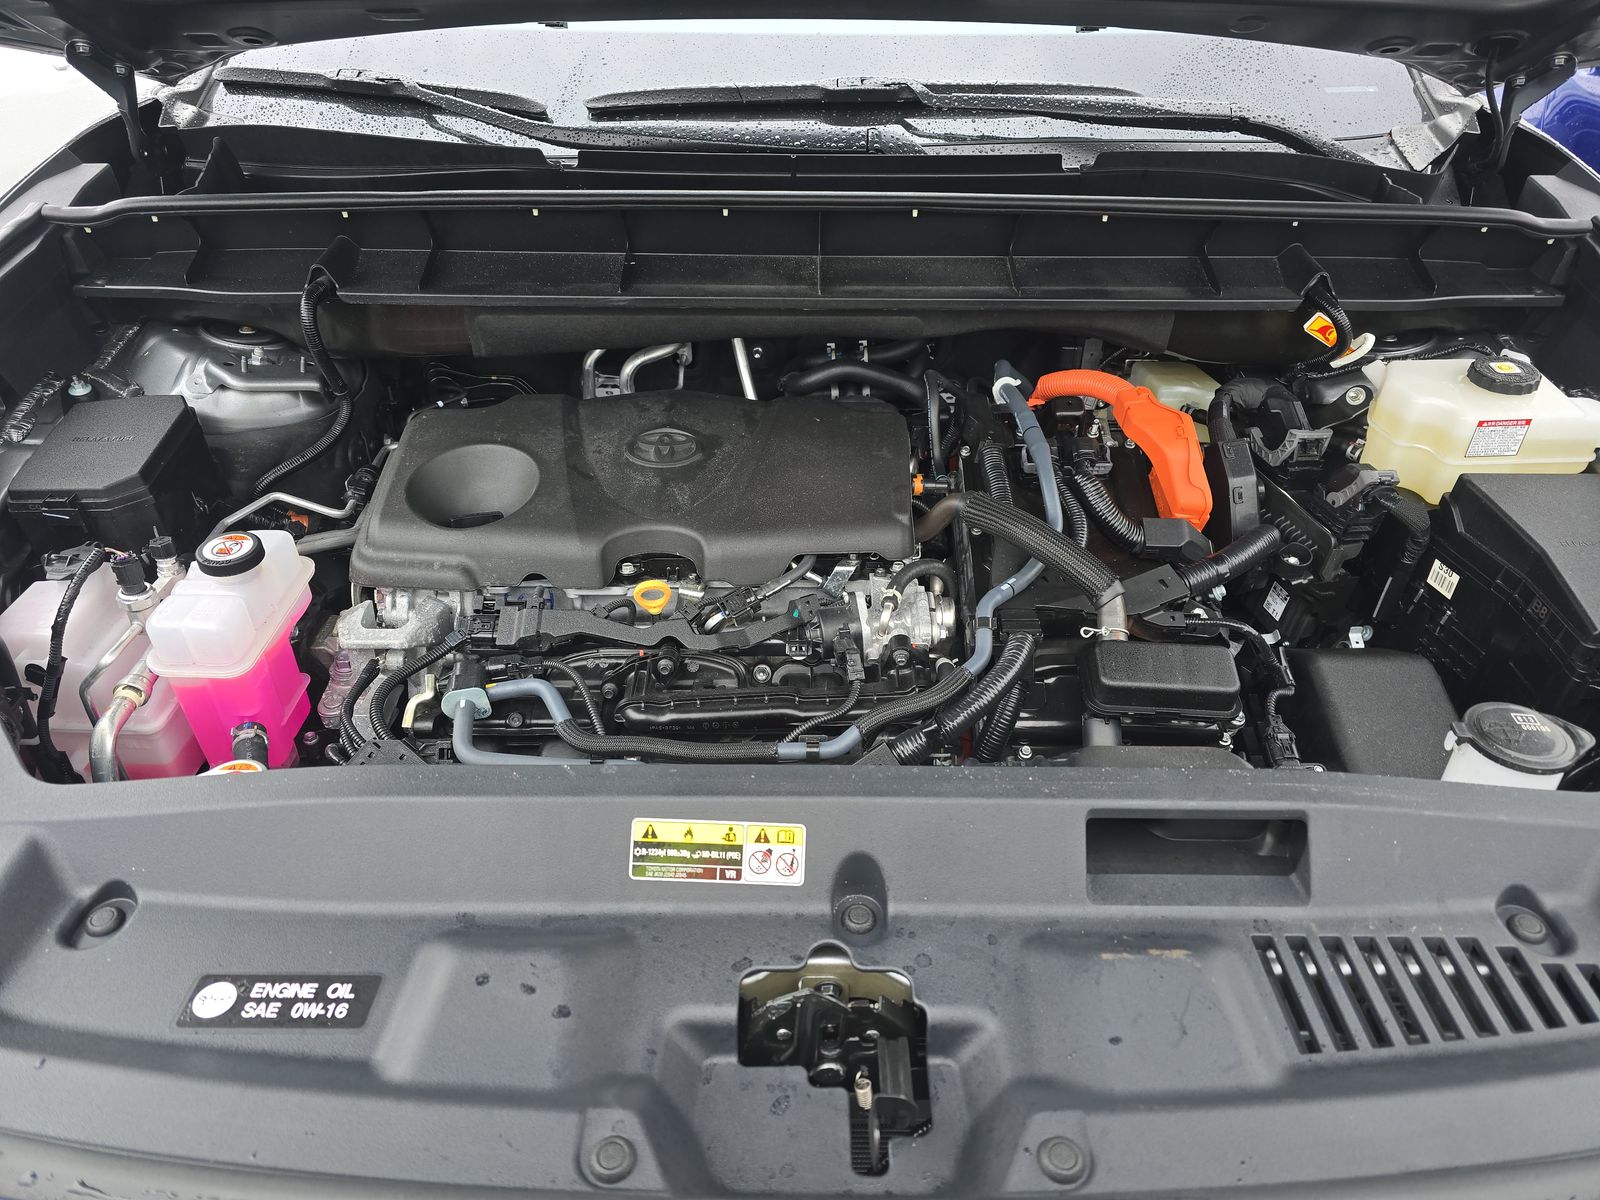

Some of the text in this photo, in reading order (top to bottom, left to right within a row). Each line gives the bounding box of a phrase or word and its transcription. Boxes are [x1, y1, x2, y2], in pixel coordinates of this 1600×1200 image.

[725, 869, 737, 879] VR
[249, 982, 319, 999] ENGINE
[326, 983, 355, 999] OIL
[240, 1002, 350, 1019] SAE 0W-16
